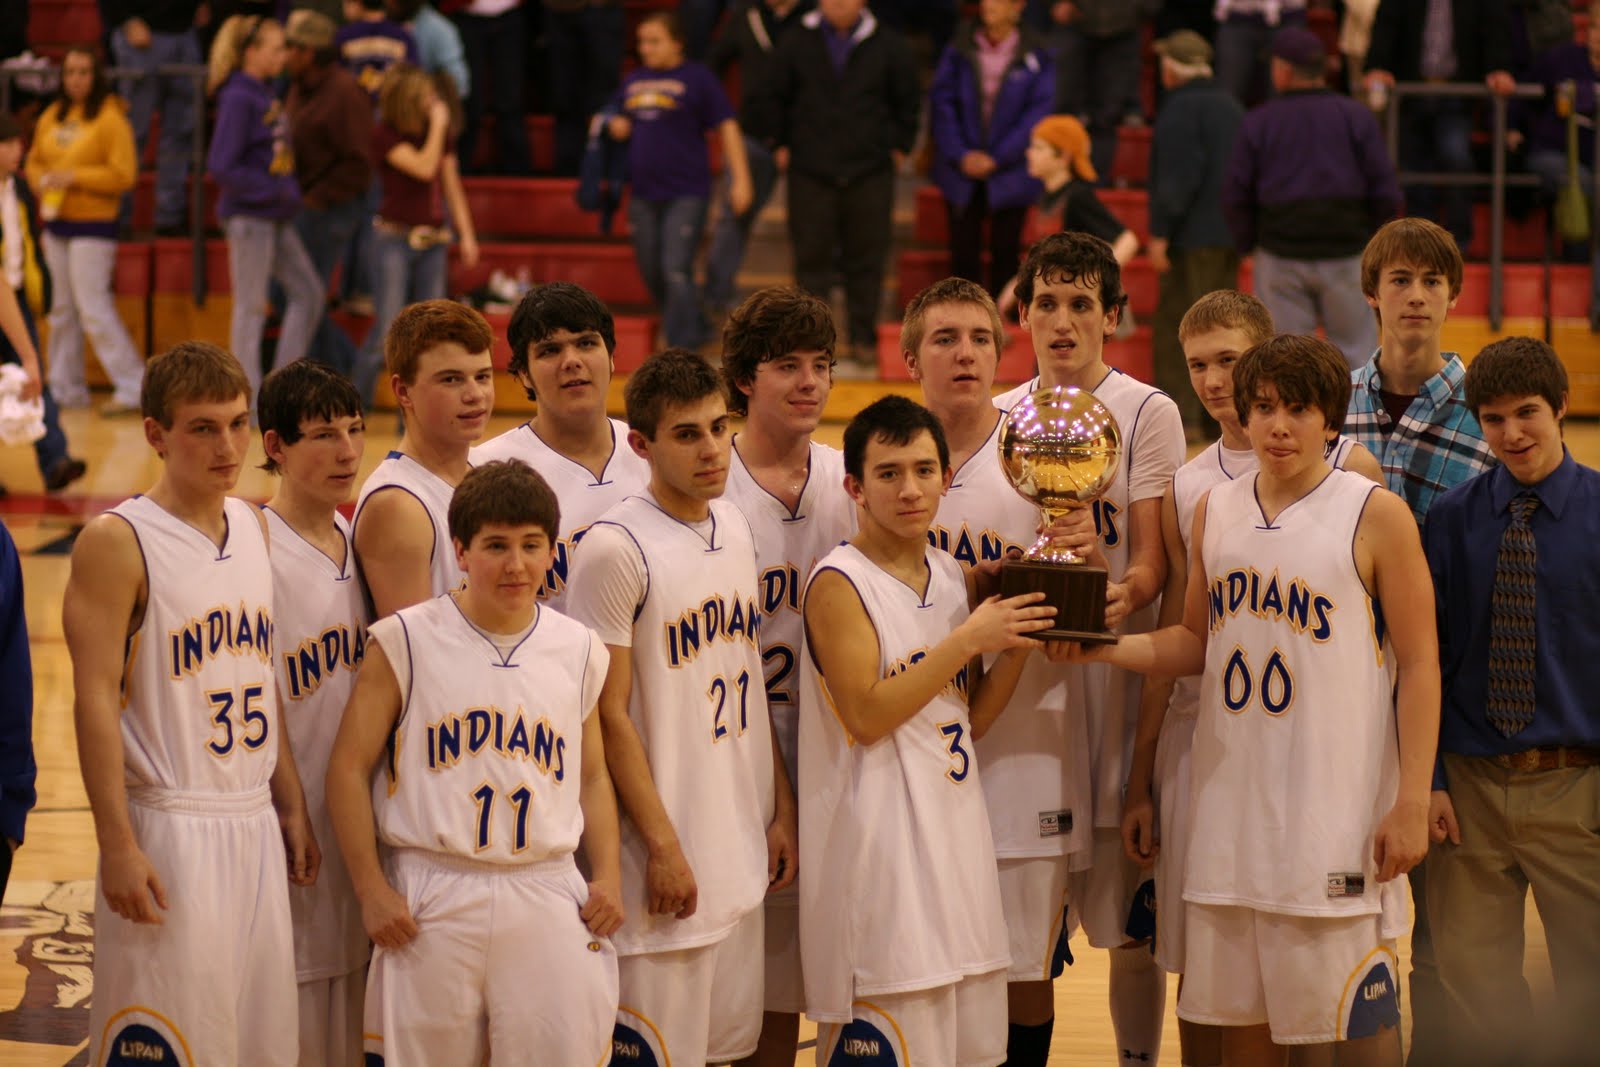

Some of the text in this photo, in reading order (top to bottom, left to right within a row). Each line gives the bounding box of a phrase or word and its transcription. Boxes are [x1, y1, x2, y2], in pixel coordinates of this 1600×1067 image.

[168, 600, 273, 682] INDIAN
[664, 588, 761, 669] INDIAN
[1207, 564, 1337, 643] INDIANS
[282, 615, 367, 701] INDIA
[1221, 643, 1295, 717] 00
[203, 682, 270, 760] 35
[706, 664, 750, 744] 21
[424, 703, 566, 786] INDIANS
[936, 719, 970, 785] 3
[469, 779, 536, 855] 11
[120, 1040, 164, 1062] LIPAN
[844, 1037, 880, 1057] LIPAN
